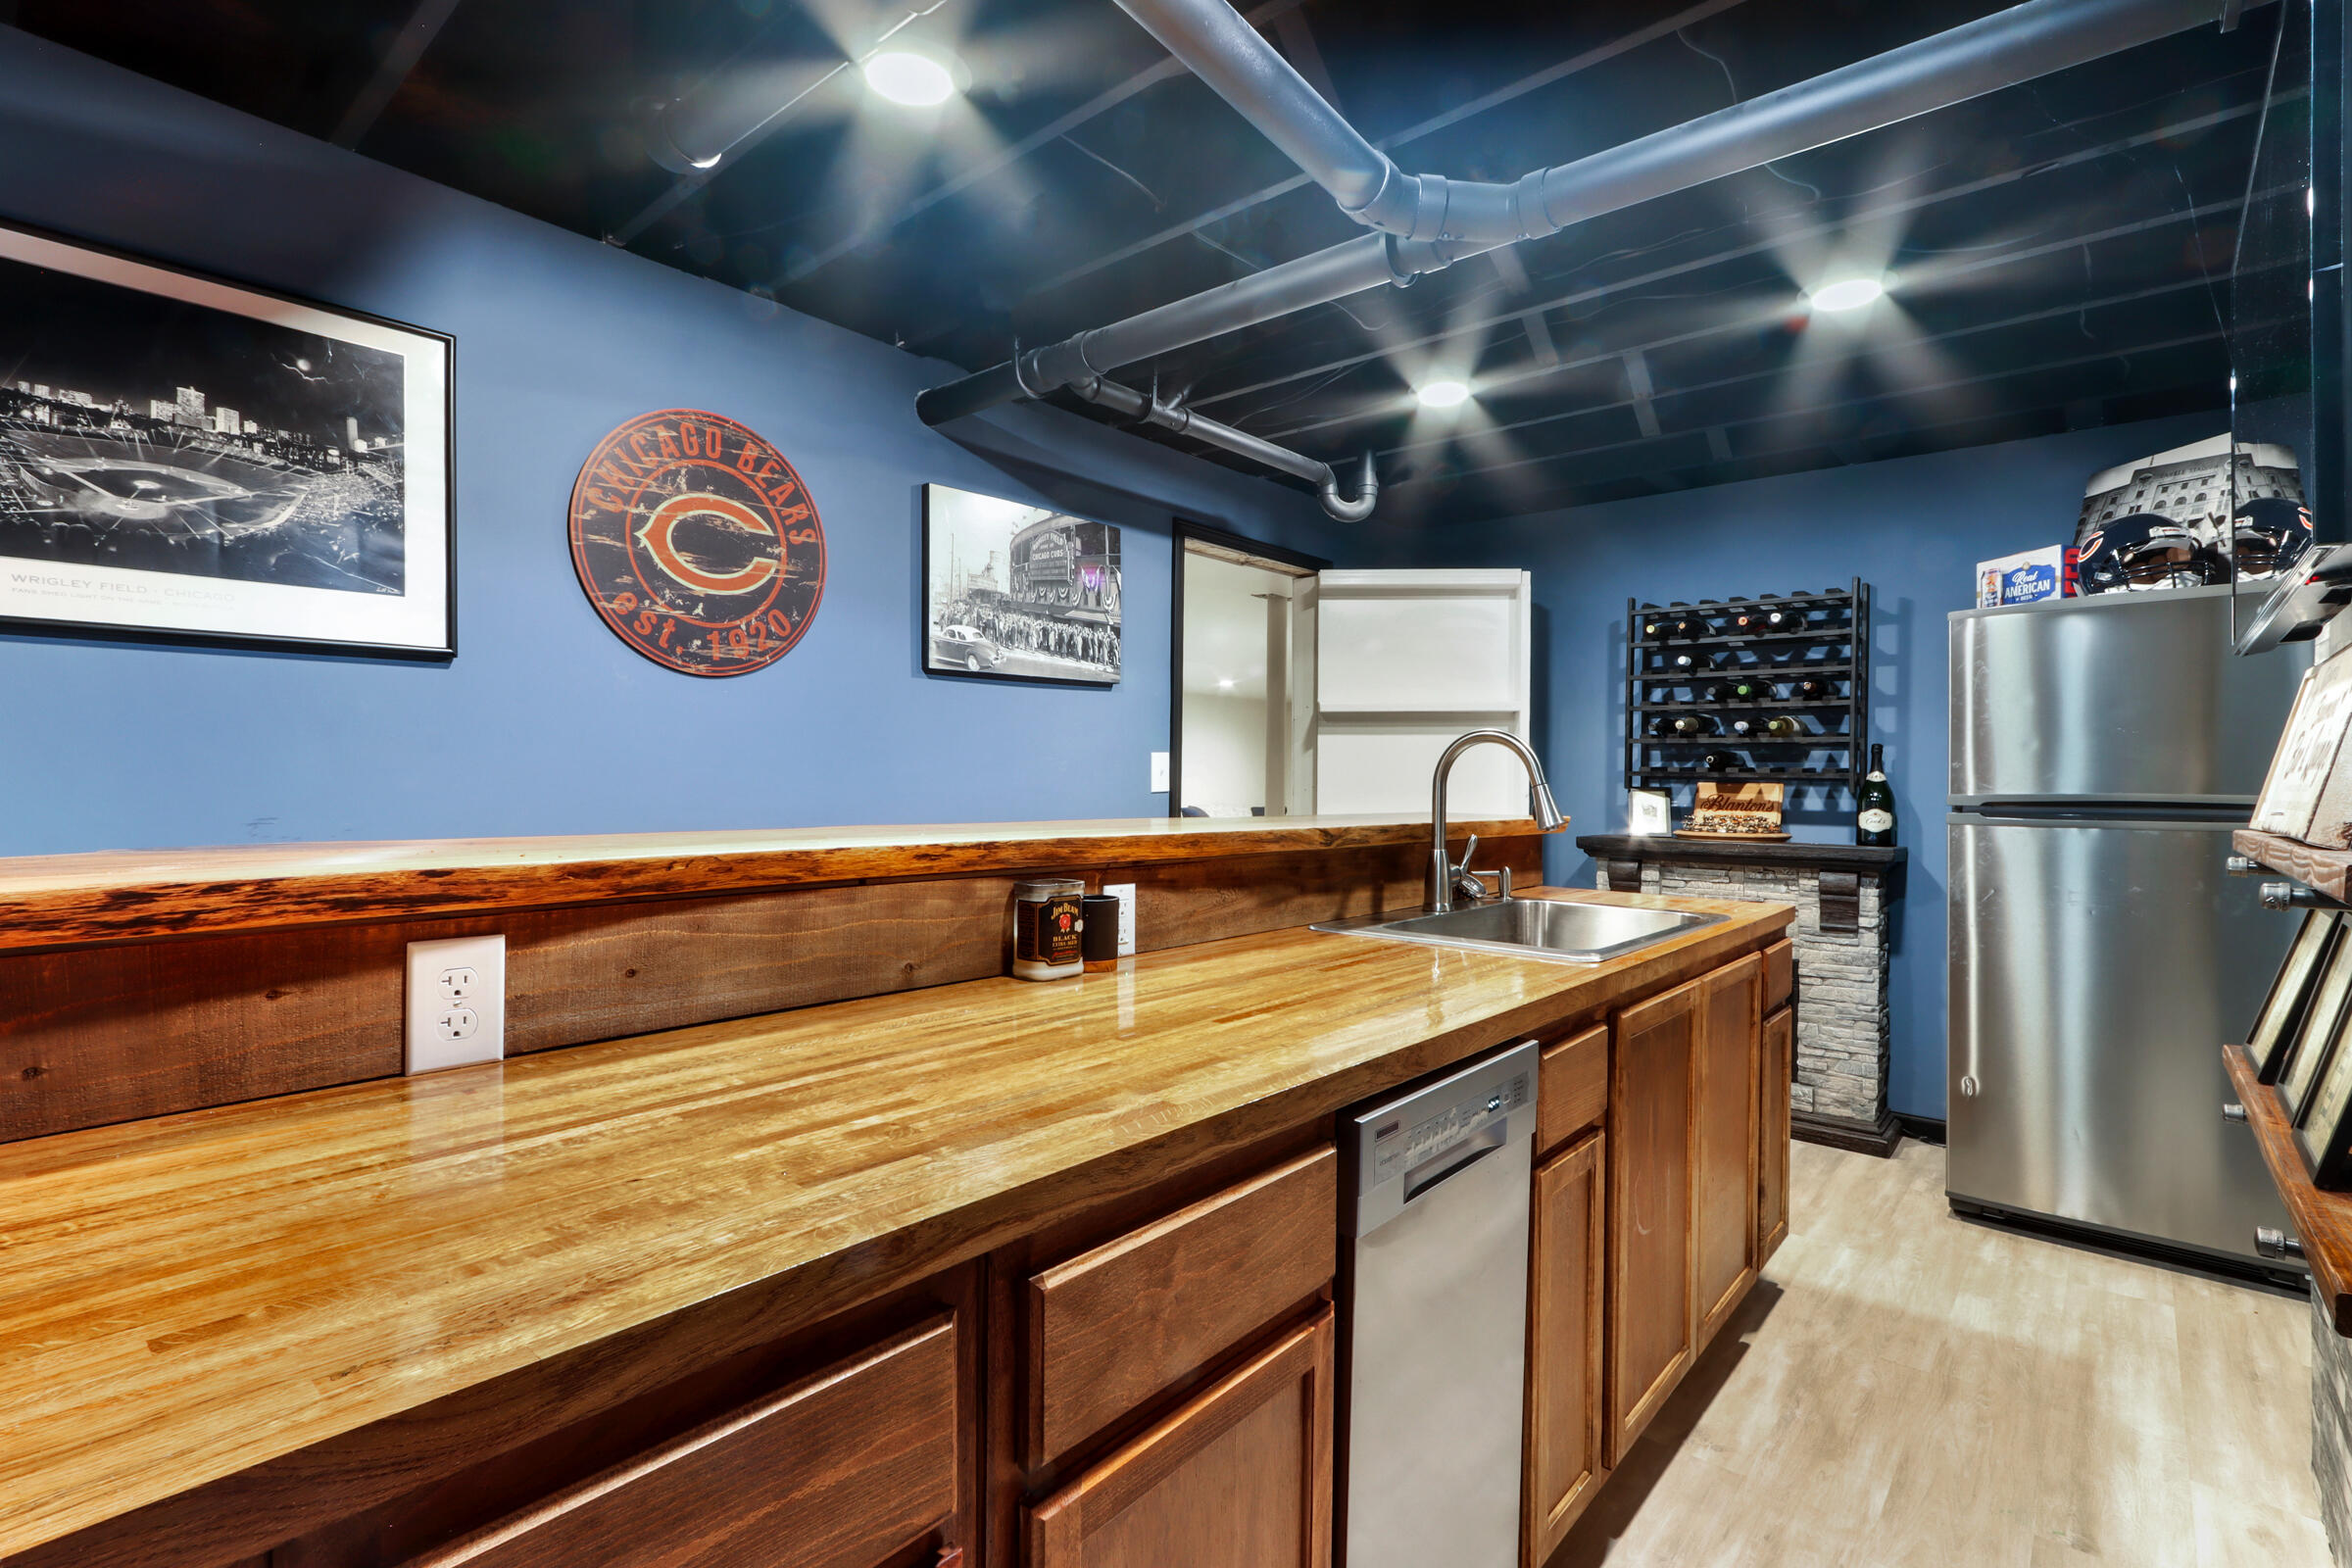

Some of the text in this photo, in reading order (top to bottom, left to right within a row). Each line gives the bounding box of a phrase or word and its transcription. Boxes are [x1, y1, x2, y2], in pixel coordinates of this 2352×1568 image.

[587, 422, 817, 545] CHICAGO BEARS
[1050, 549, 1064, 559] CUBS
[11, 573, 235, 602] WRIGLEY FIELD CHICAGO
[2011, 570, 2039, 586] Real
[2004, 579, 2051, 599] AMERICAN
[706, 609, 793, 662] 1920
[1700, 794, 1775, 812] Blanton's
[1051, 903, 1079, 920] JIM BEAM
